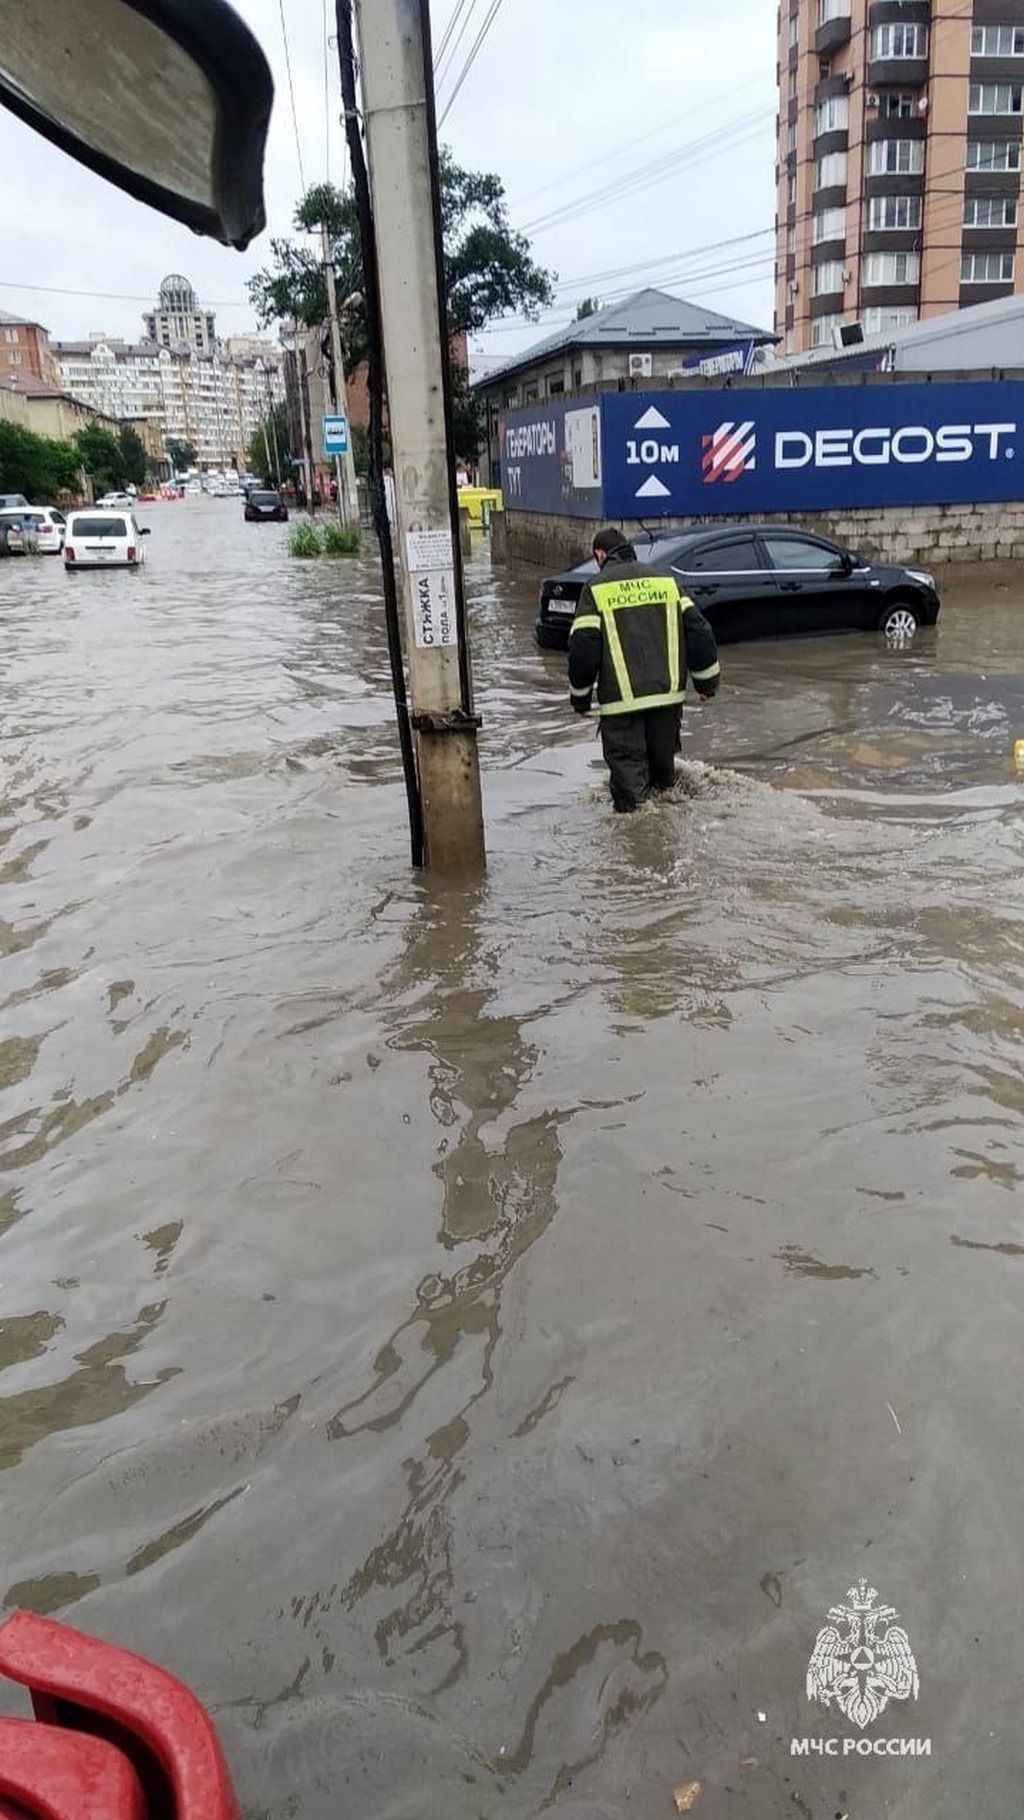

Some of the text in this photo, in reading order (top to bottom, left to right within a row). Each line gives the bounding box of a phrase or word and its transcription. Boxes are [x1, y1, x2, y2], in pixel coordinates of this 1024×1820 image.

[506, 420, 556, 458] ГЕНЕРАТОРЫ
[775, 423, 1016, 468] DEGOST
[507, 466, 521, 495] ТУТ
[607, 591, 668, 606] РОССИИ
[619, 579, 652, 592] МЧС
[418, 577, 434, 645] СТЯЖКА
[440, 611, 450, 644] ПОЛА
